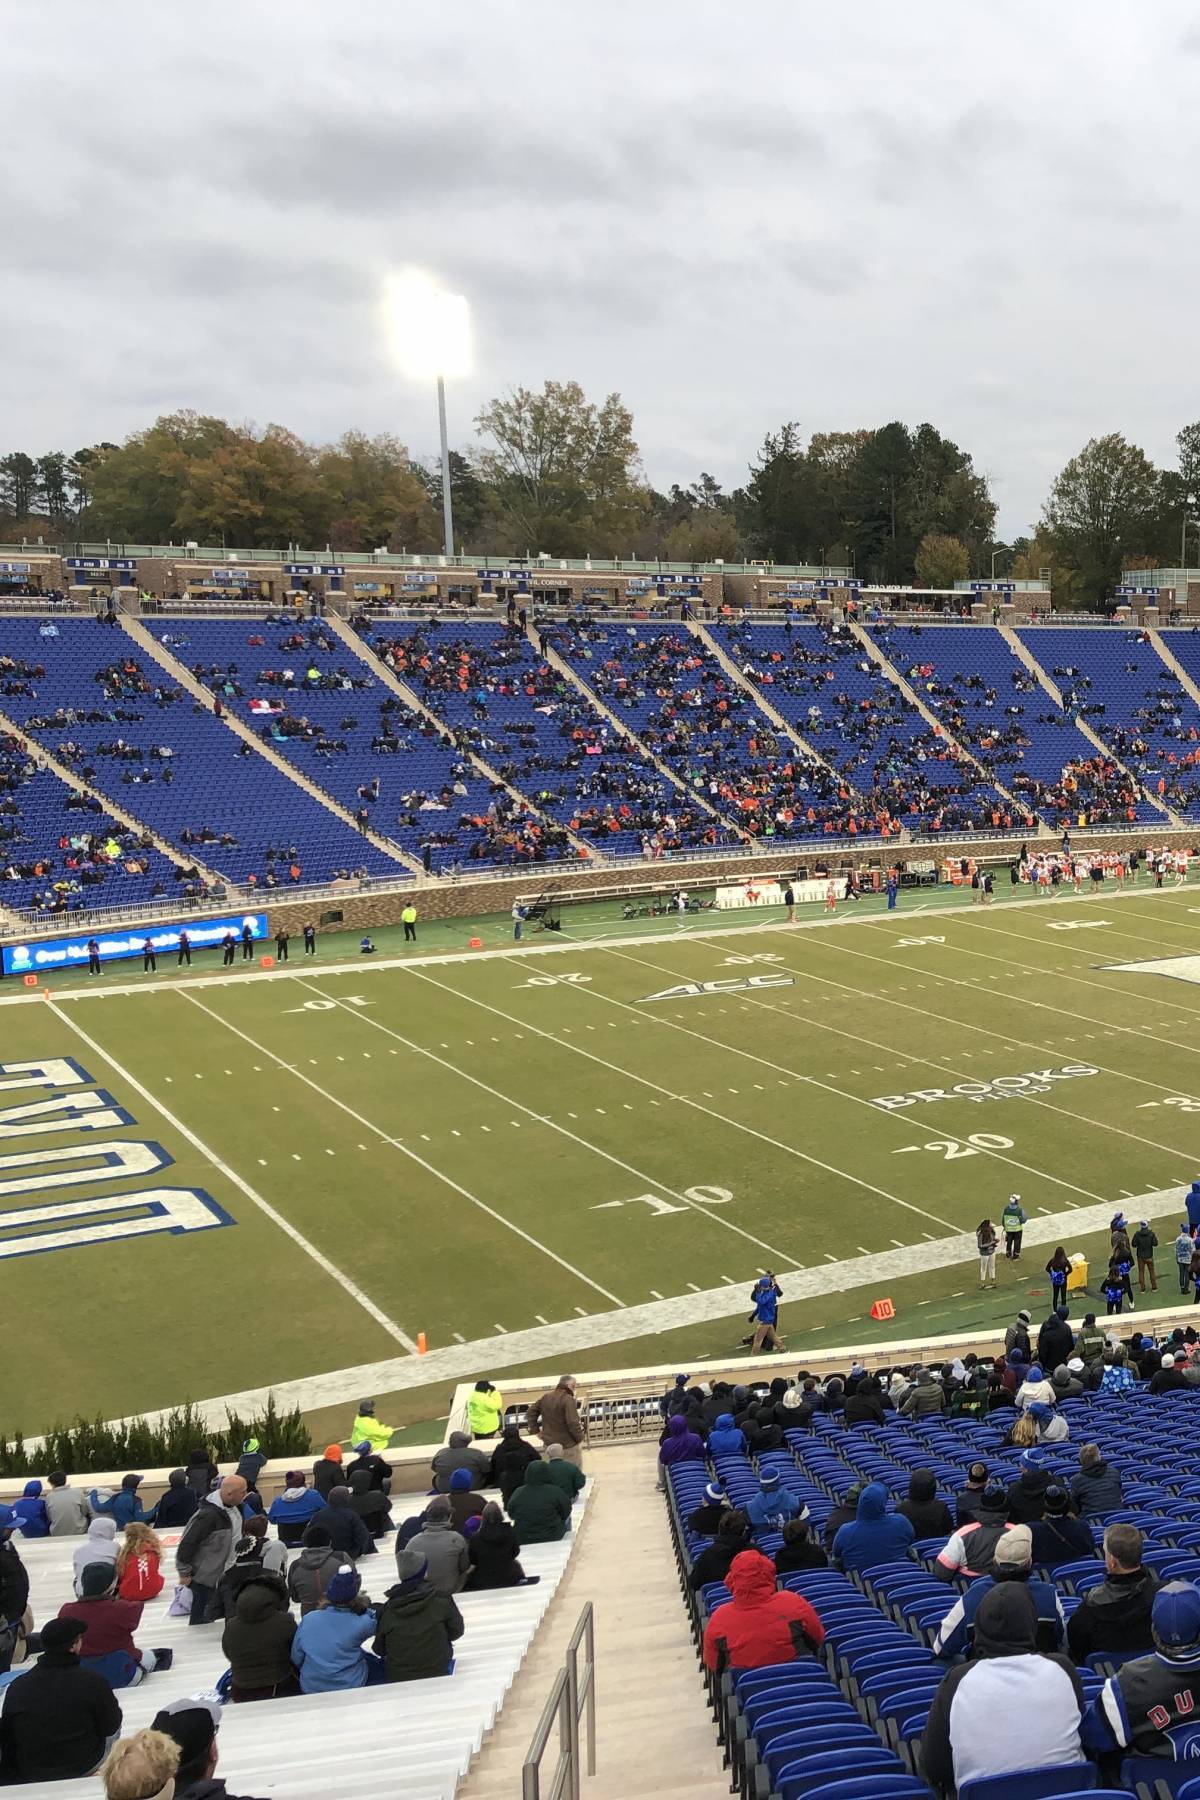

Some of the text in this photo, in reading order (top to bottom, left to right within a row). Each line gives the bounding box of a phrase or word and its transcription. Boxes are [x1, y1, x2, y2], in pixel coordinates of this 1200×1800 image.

[633, 972, 797, 1003] ACC
[867, 1064, 1101, 1111] BROOKS
[967, 1084, 1053, 1104] FIELD
[923, 1133, 1015, 1160] 20
[628, 1185, 734, 1216] 10
[877, 1301, 892, 1317] 10
